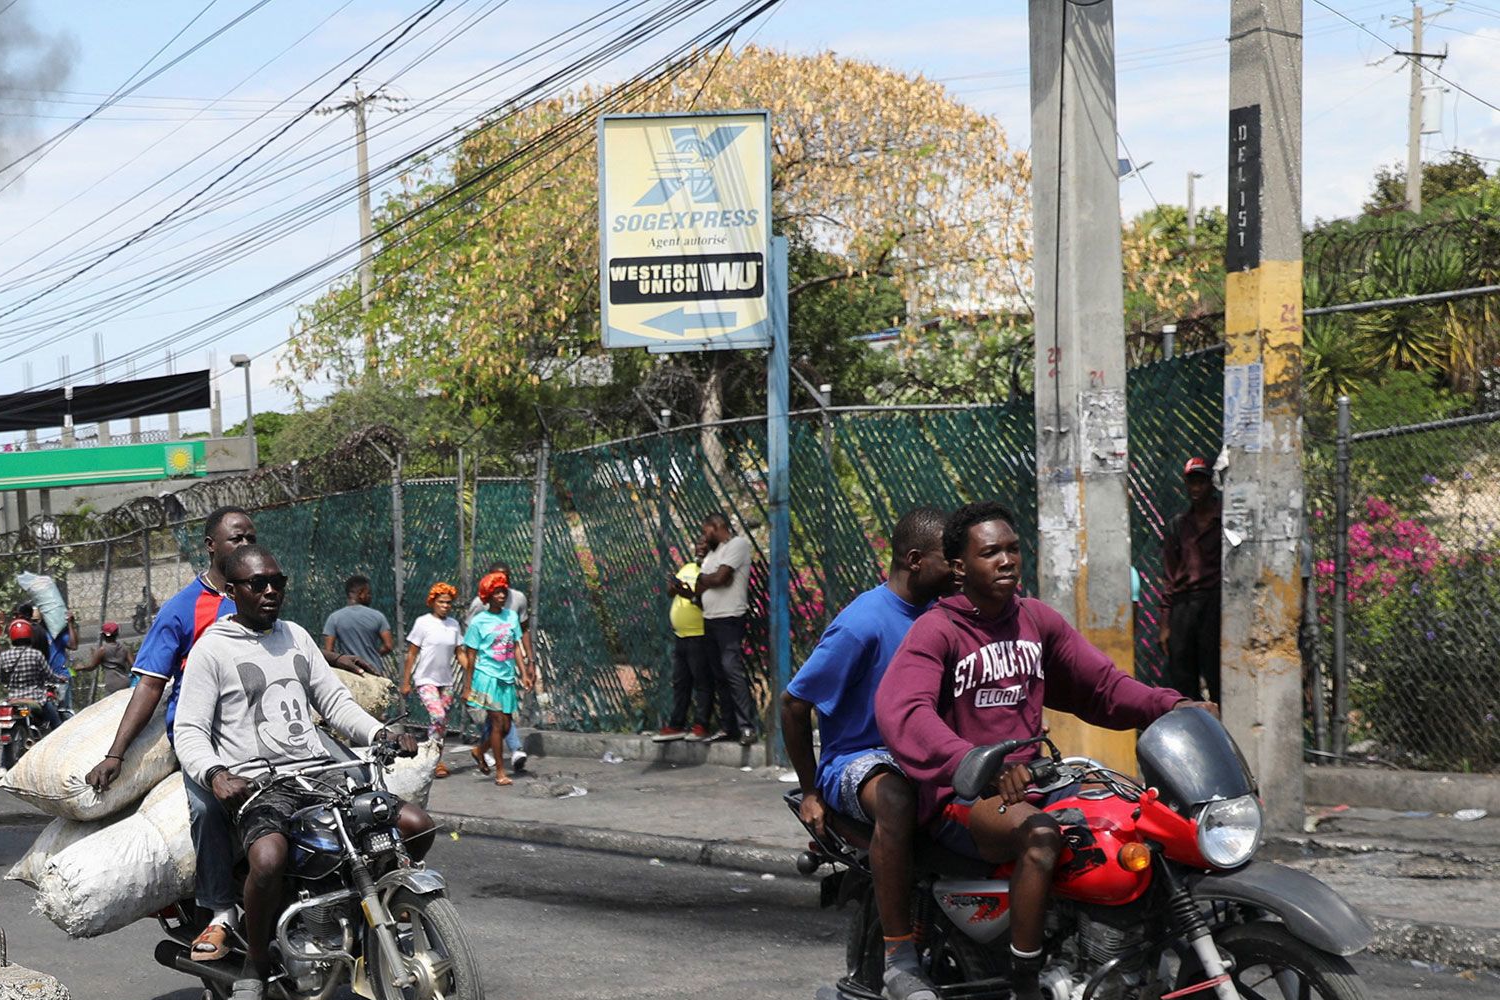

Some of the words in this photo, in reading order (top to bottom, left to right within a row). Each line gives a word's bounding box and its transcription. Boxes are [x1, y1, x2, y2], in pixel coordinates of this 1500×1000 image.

[612, 209, 759, 233] SOGEXPRESS
[648, 237, 680, 249] Agent
[683, 234, 727, 247] autorisé
[610, 263, 698, 281] WESTERN
[707, 261, 758, 292] WU
[638, 278, 698, 294] UNION
[954, 652, 977, 698] ST.
